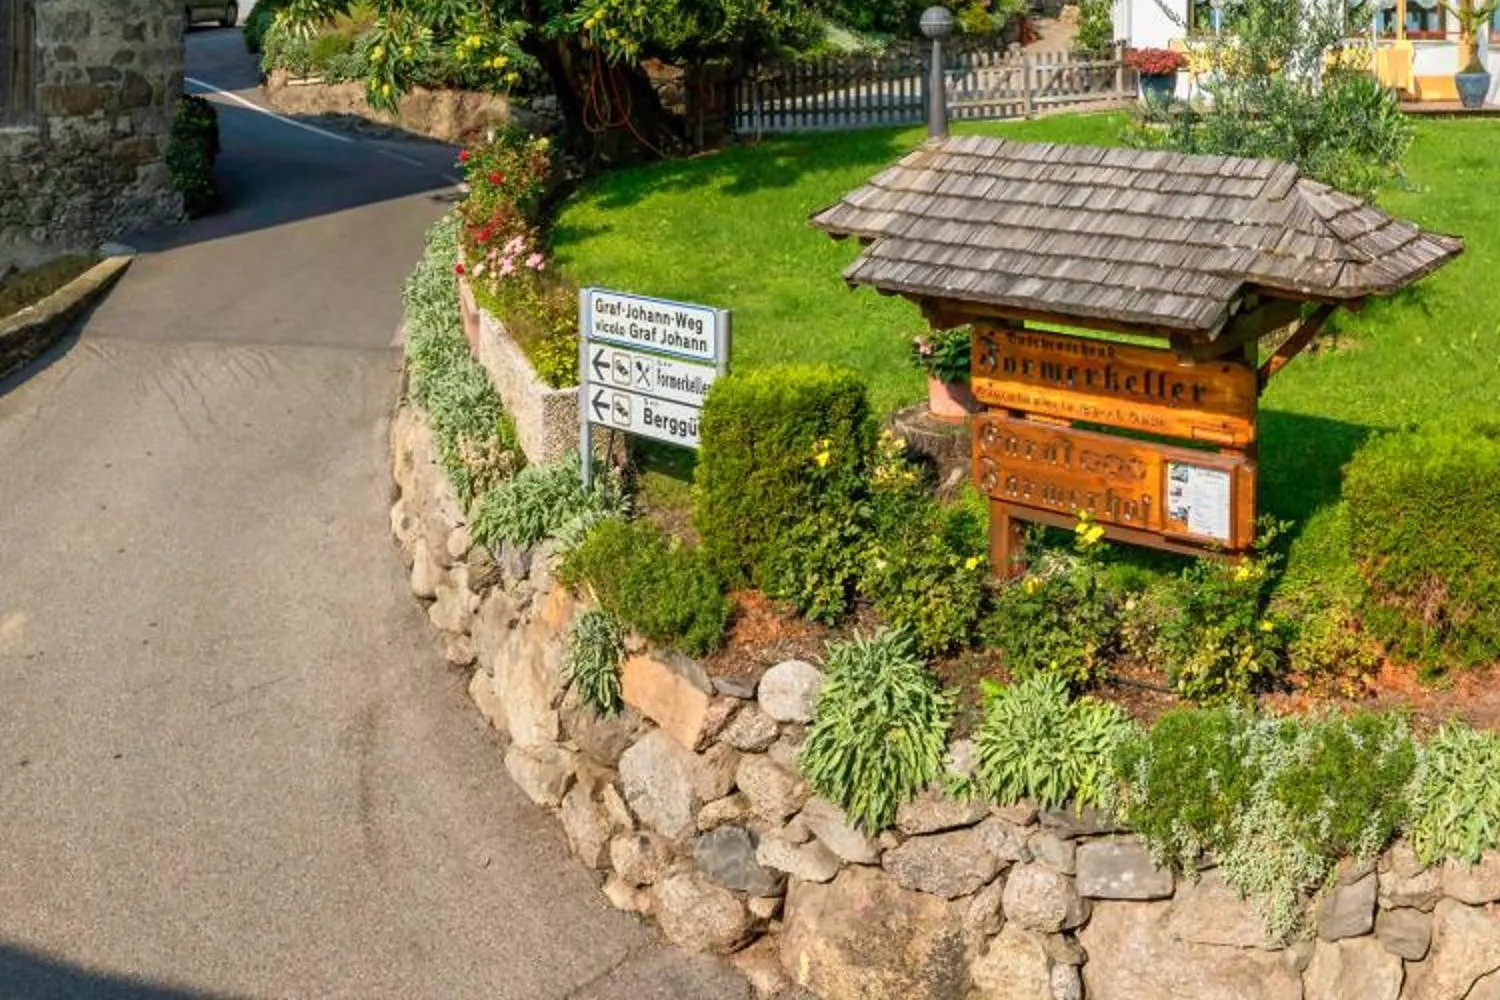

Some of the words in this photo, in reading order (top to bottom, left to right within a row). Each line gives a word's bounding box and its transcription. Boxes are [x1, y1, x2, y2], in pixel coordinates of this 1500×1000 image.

[595, 298, 703, 335] Graf-Johann-Weg
[595, 320, 626, 337] vicolo
[629, 323, 657, 342] Graf
[661, 329, 707, 353] Johann
[643, 407, 698, 437] Berggü
